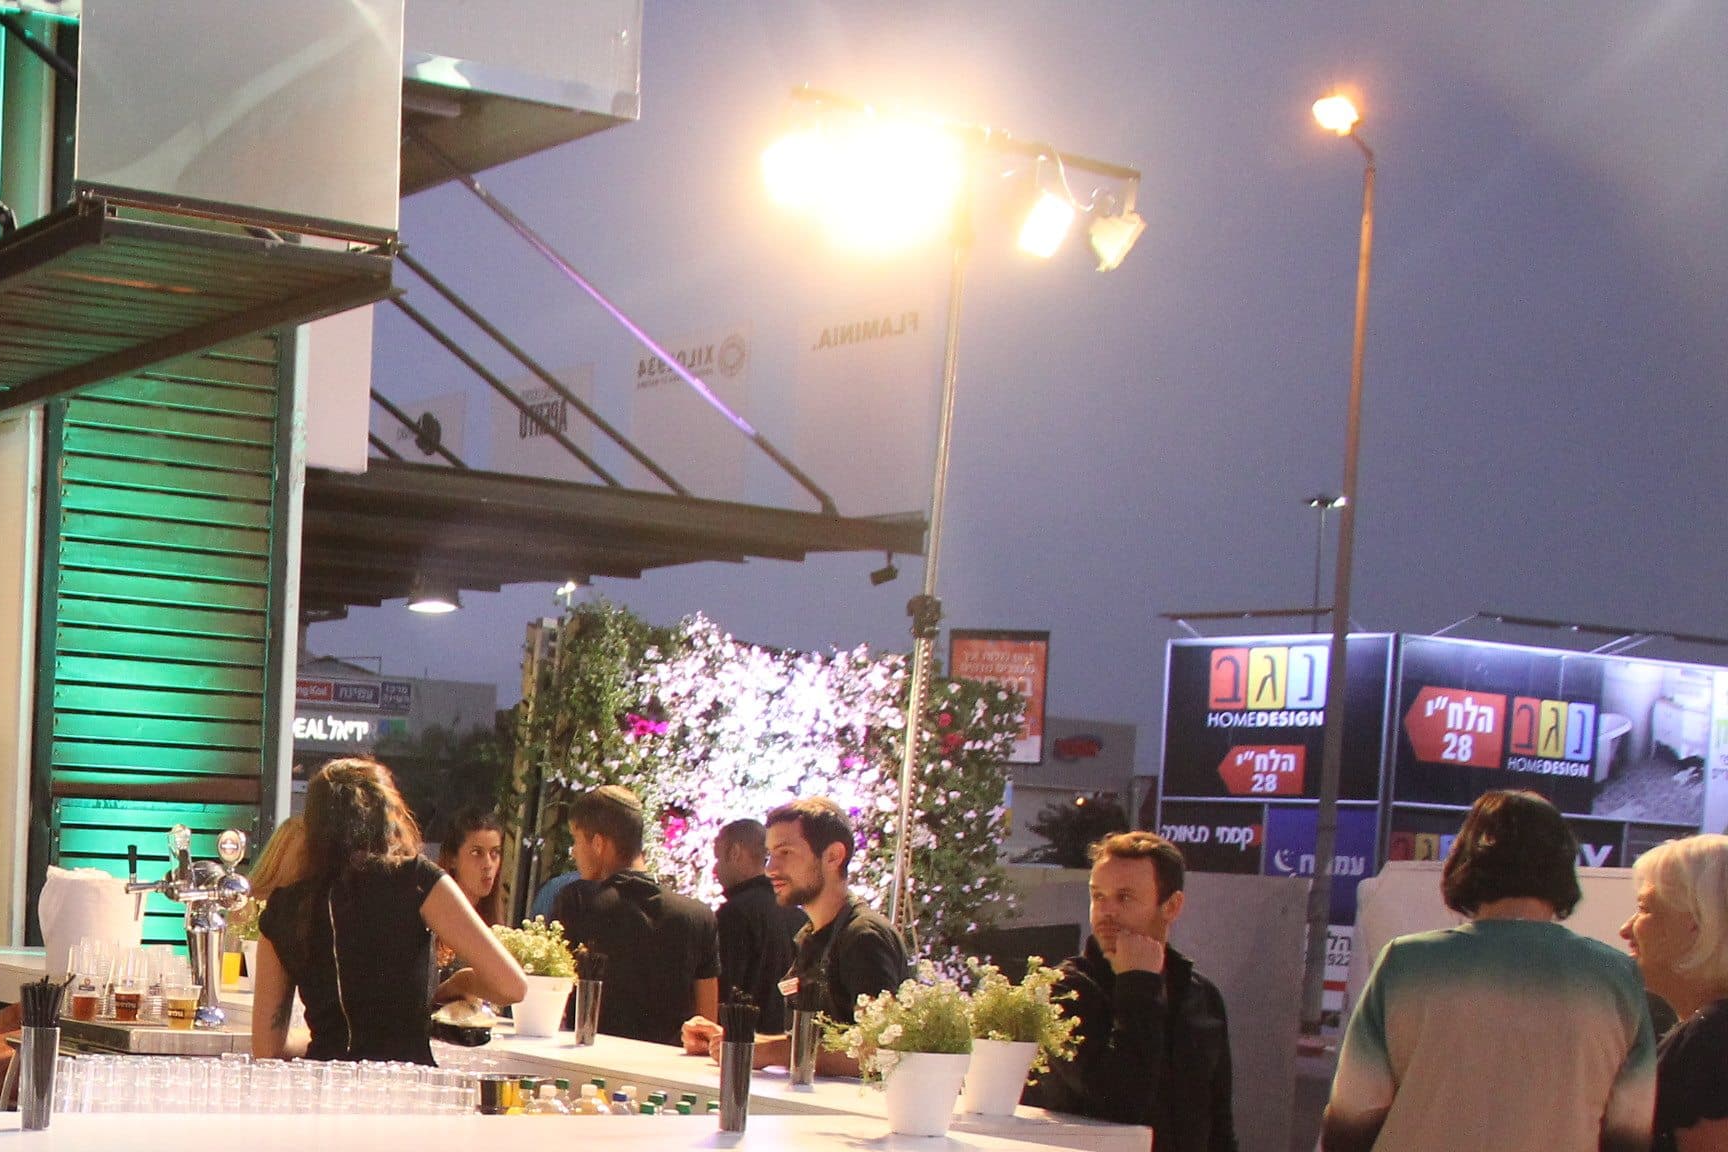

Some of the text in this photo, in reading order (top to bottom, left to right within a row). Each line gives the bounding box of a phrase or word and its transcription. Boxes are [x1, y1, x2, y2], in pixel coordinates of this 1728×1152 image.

[1216, 654, 1315, 702] נגב
[1207, 710, 1324, 727] HOMEDESIGN
[1515, 703, 1585, 755] נגב
[1441, 732, 1473, 763] 28
[1507, 757, 1590, 777] HOMEDESIGN
[1251, 773, 1278, 792] 28
